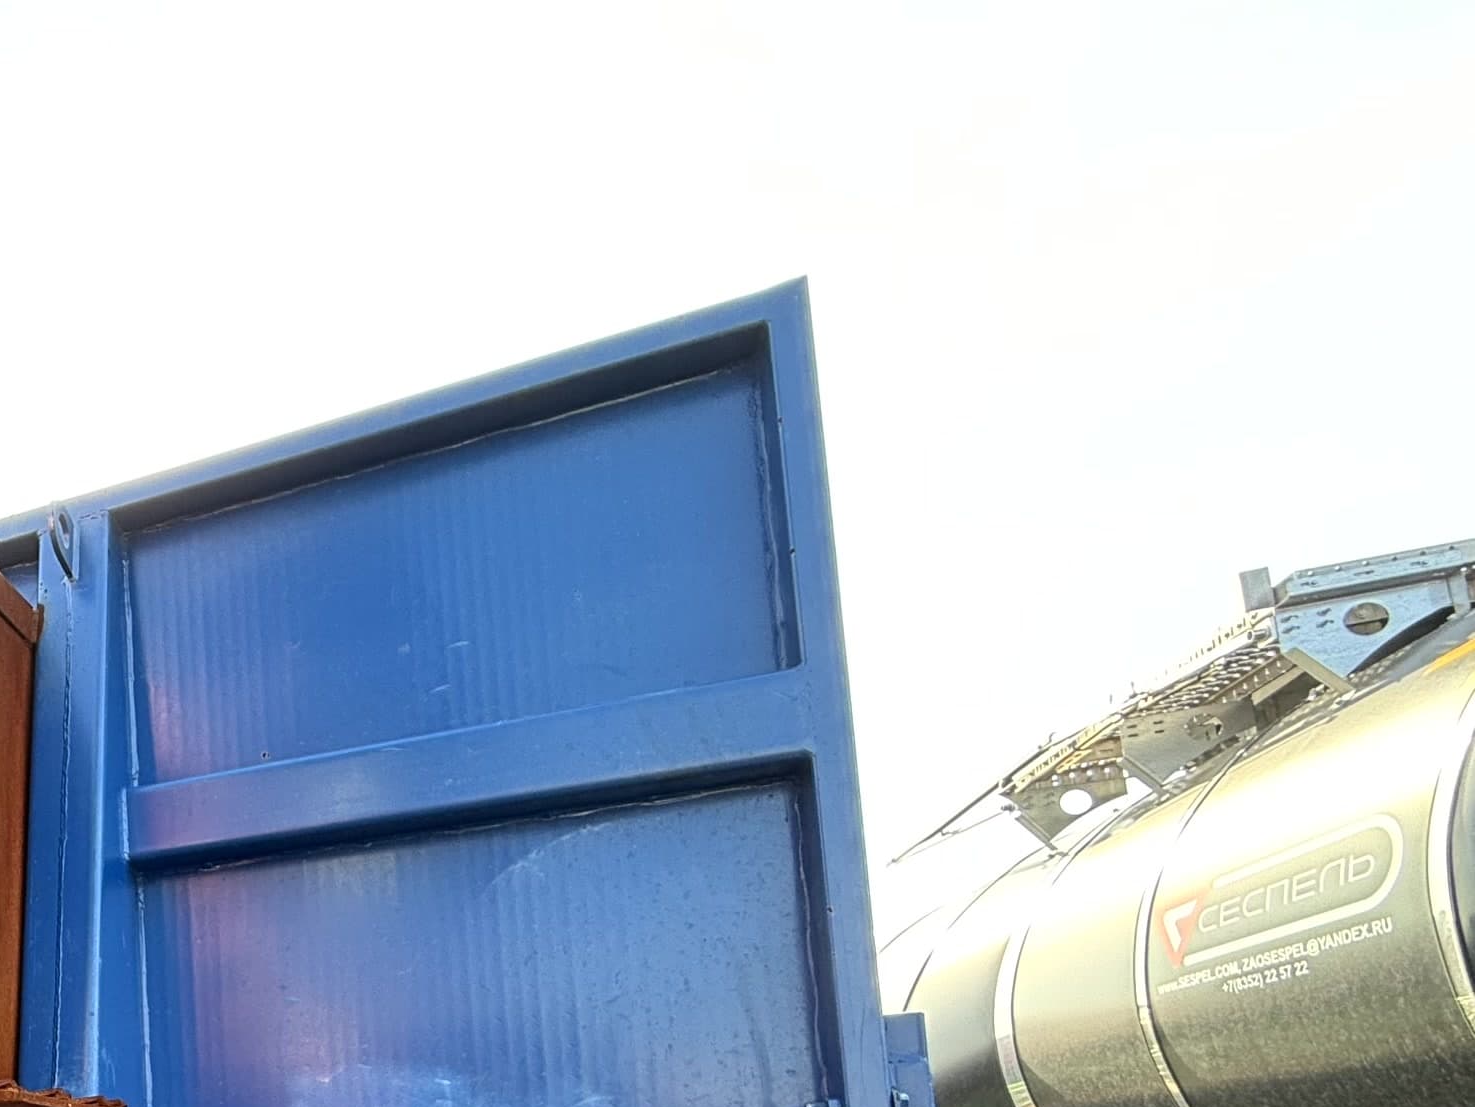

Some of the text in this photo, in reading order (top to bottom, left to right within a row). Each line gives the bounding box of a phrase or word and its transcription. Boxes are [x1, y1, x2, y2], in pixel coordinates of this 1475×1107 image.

[1198, 854, 1375, 932] СЕСПЕЛЬ
[1242, 917, 1392, 971] ZAOSESPEL@YANDEX.RU
[1222, 960, 1309, 993] +7(8352) 22 57 22
